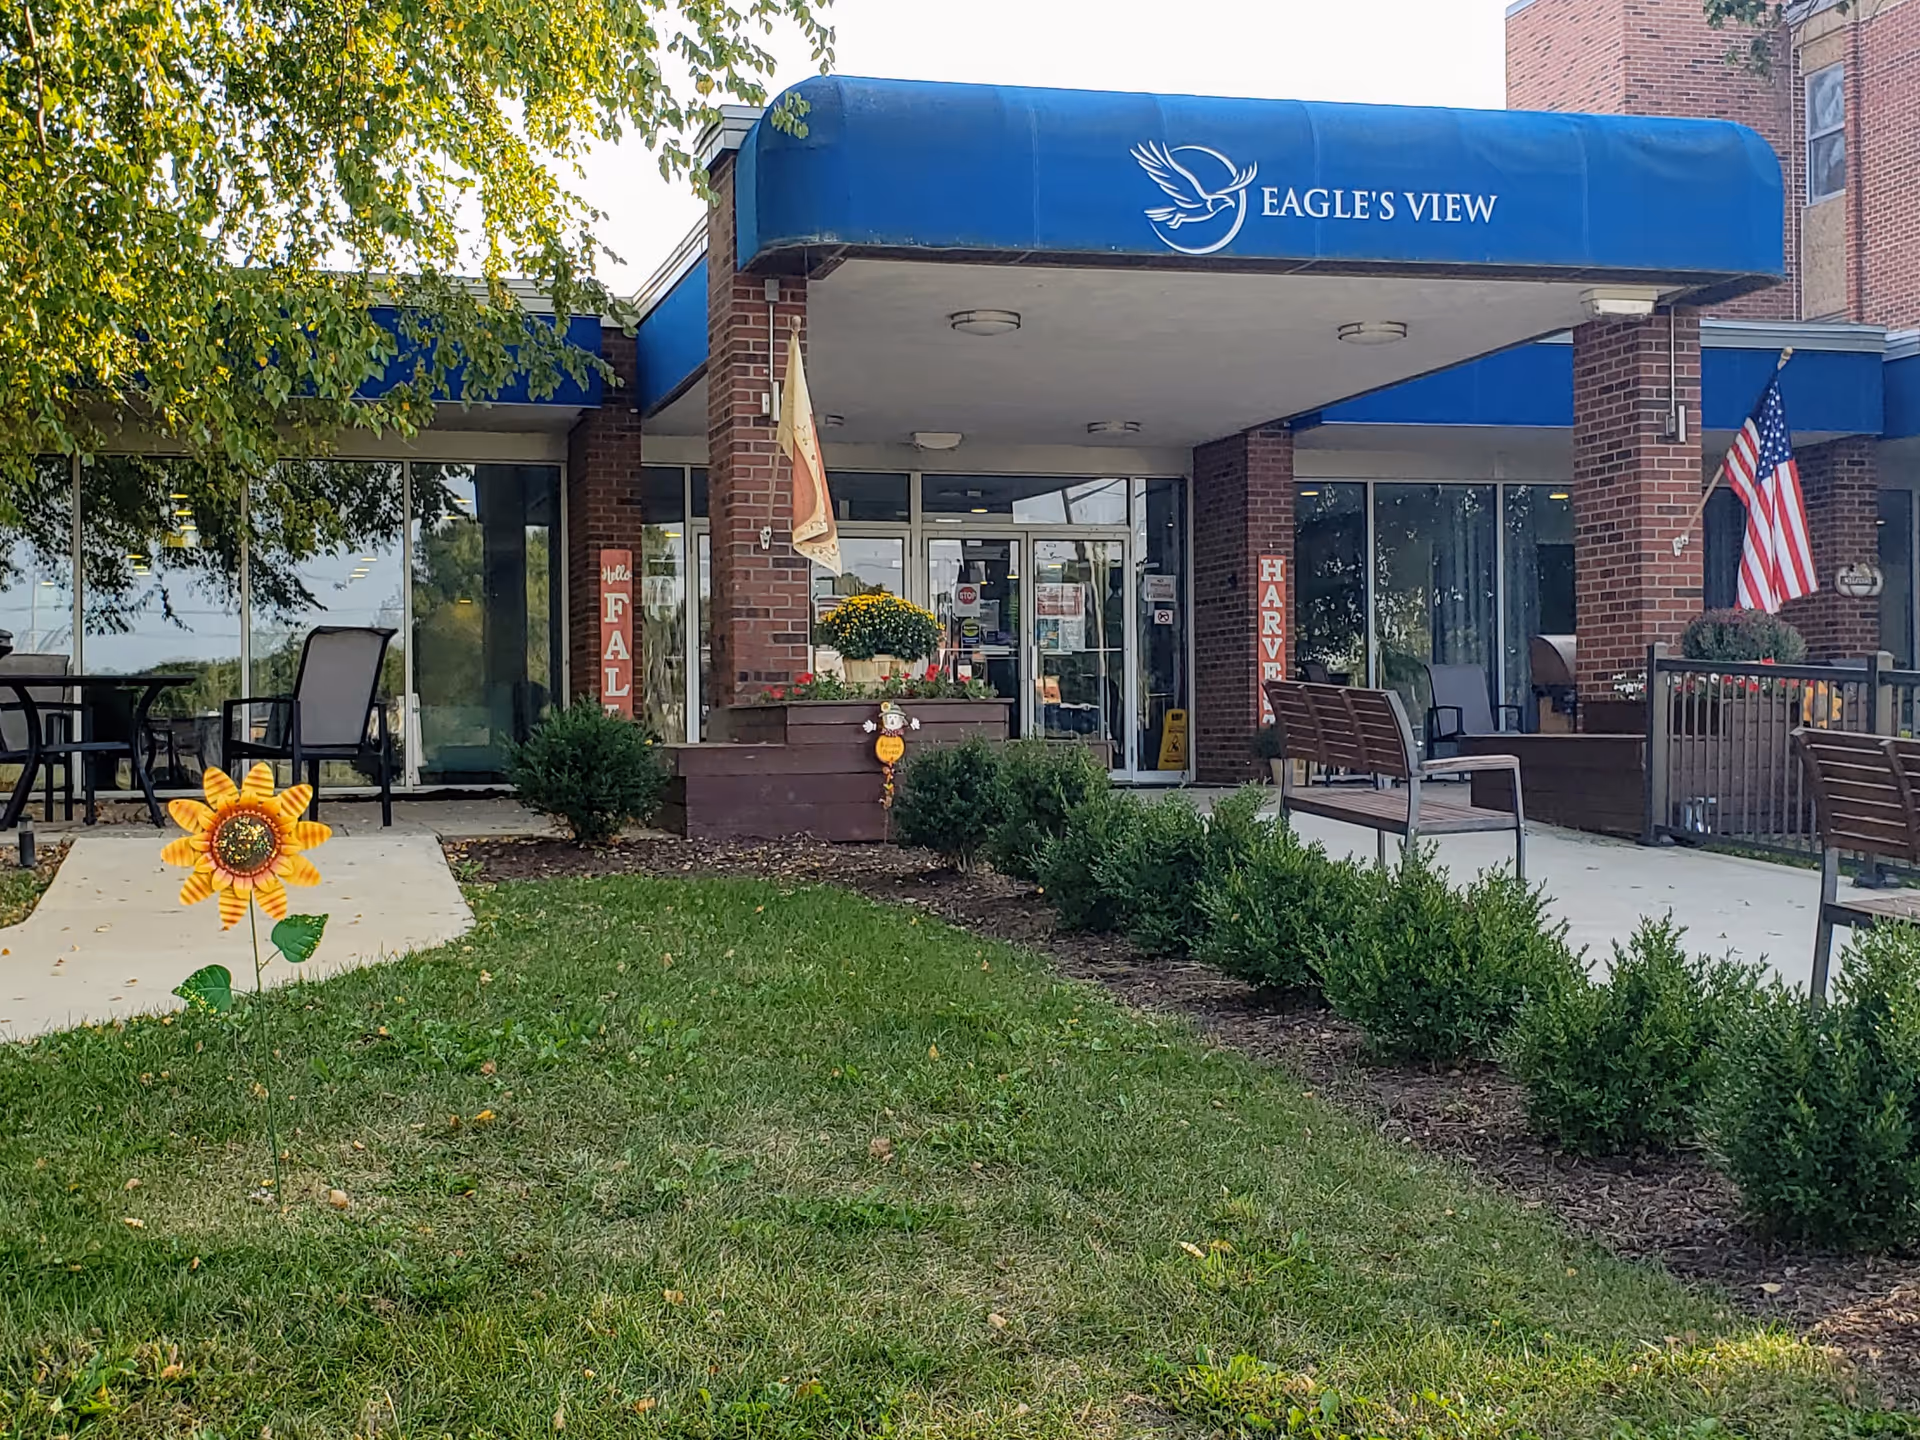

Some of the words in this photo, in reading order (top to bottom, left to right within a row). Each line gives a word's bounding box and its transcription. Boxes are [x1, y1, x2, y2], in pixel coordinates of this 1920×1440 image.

[1261, 187, 1395, 220] EAGLE'S
[1403, 191, 1498, 223] VIEW
[601, 565, 632, 585] Hello
[959, 591, 976, 600] STOP
